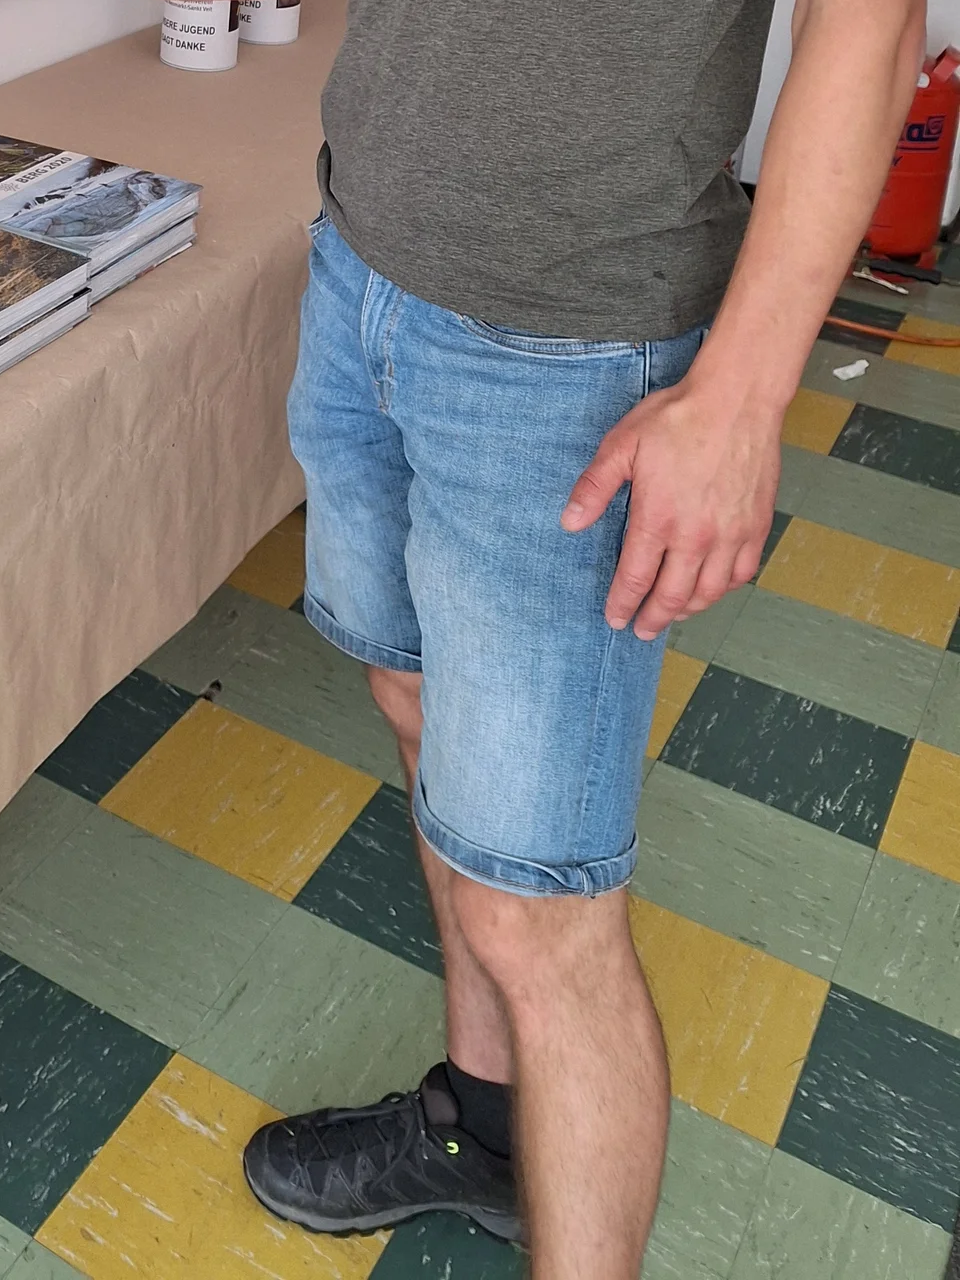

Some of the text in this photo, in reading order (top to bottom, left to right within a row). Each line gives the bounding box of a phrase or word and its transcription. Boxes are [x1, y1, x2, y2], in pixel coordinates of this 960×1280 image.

[179, 24, 216, 36] JUGEND
[175, 39, 206, 51] DANKE
[15, 168, 49, 183] BERG
[43, 156, 73, 169] 2020
